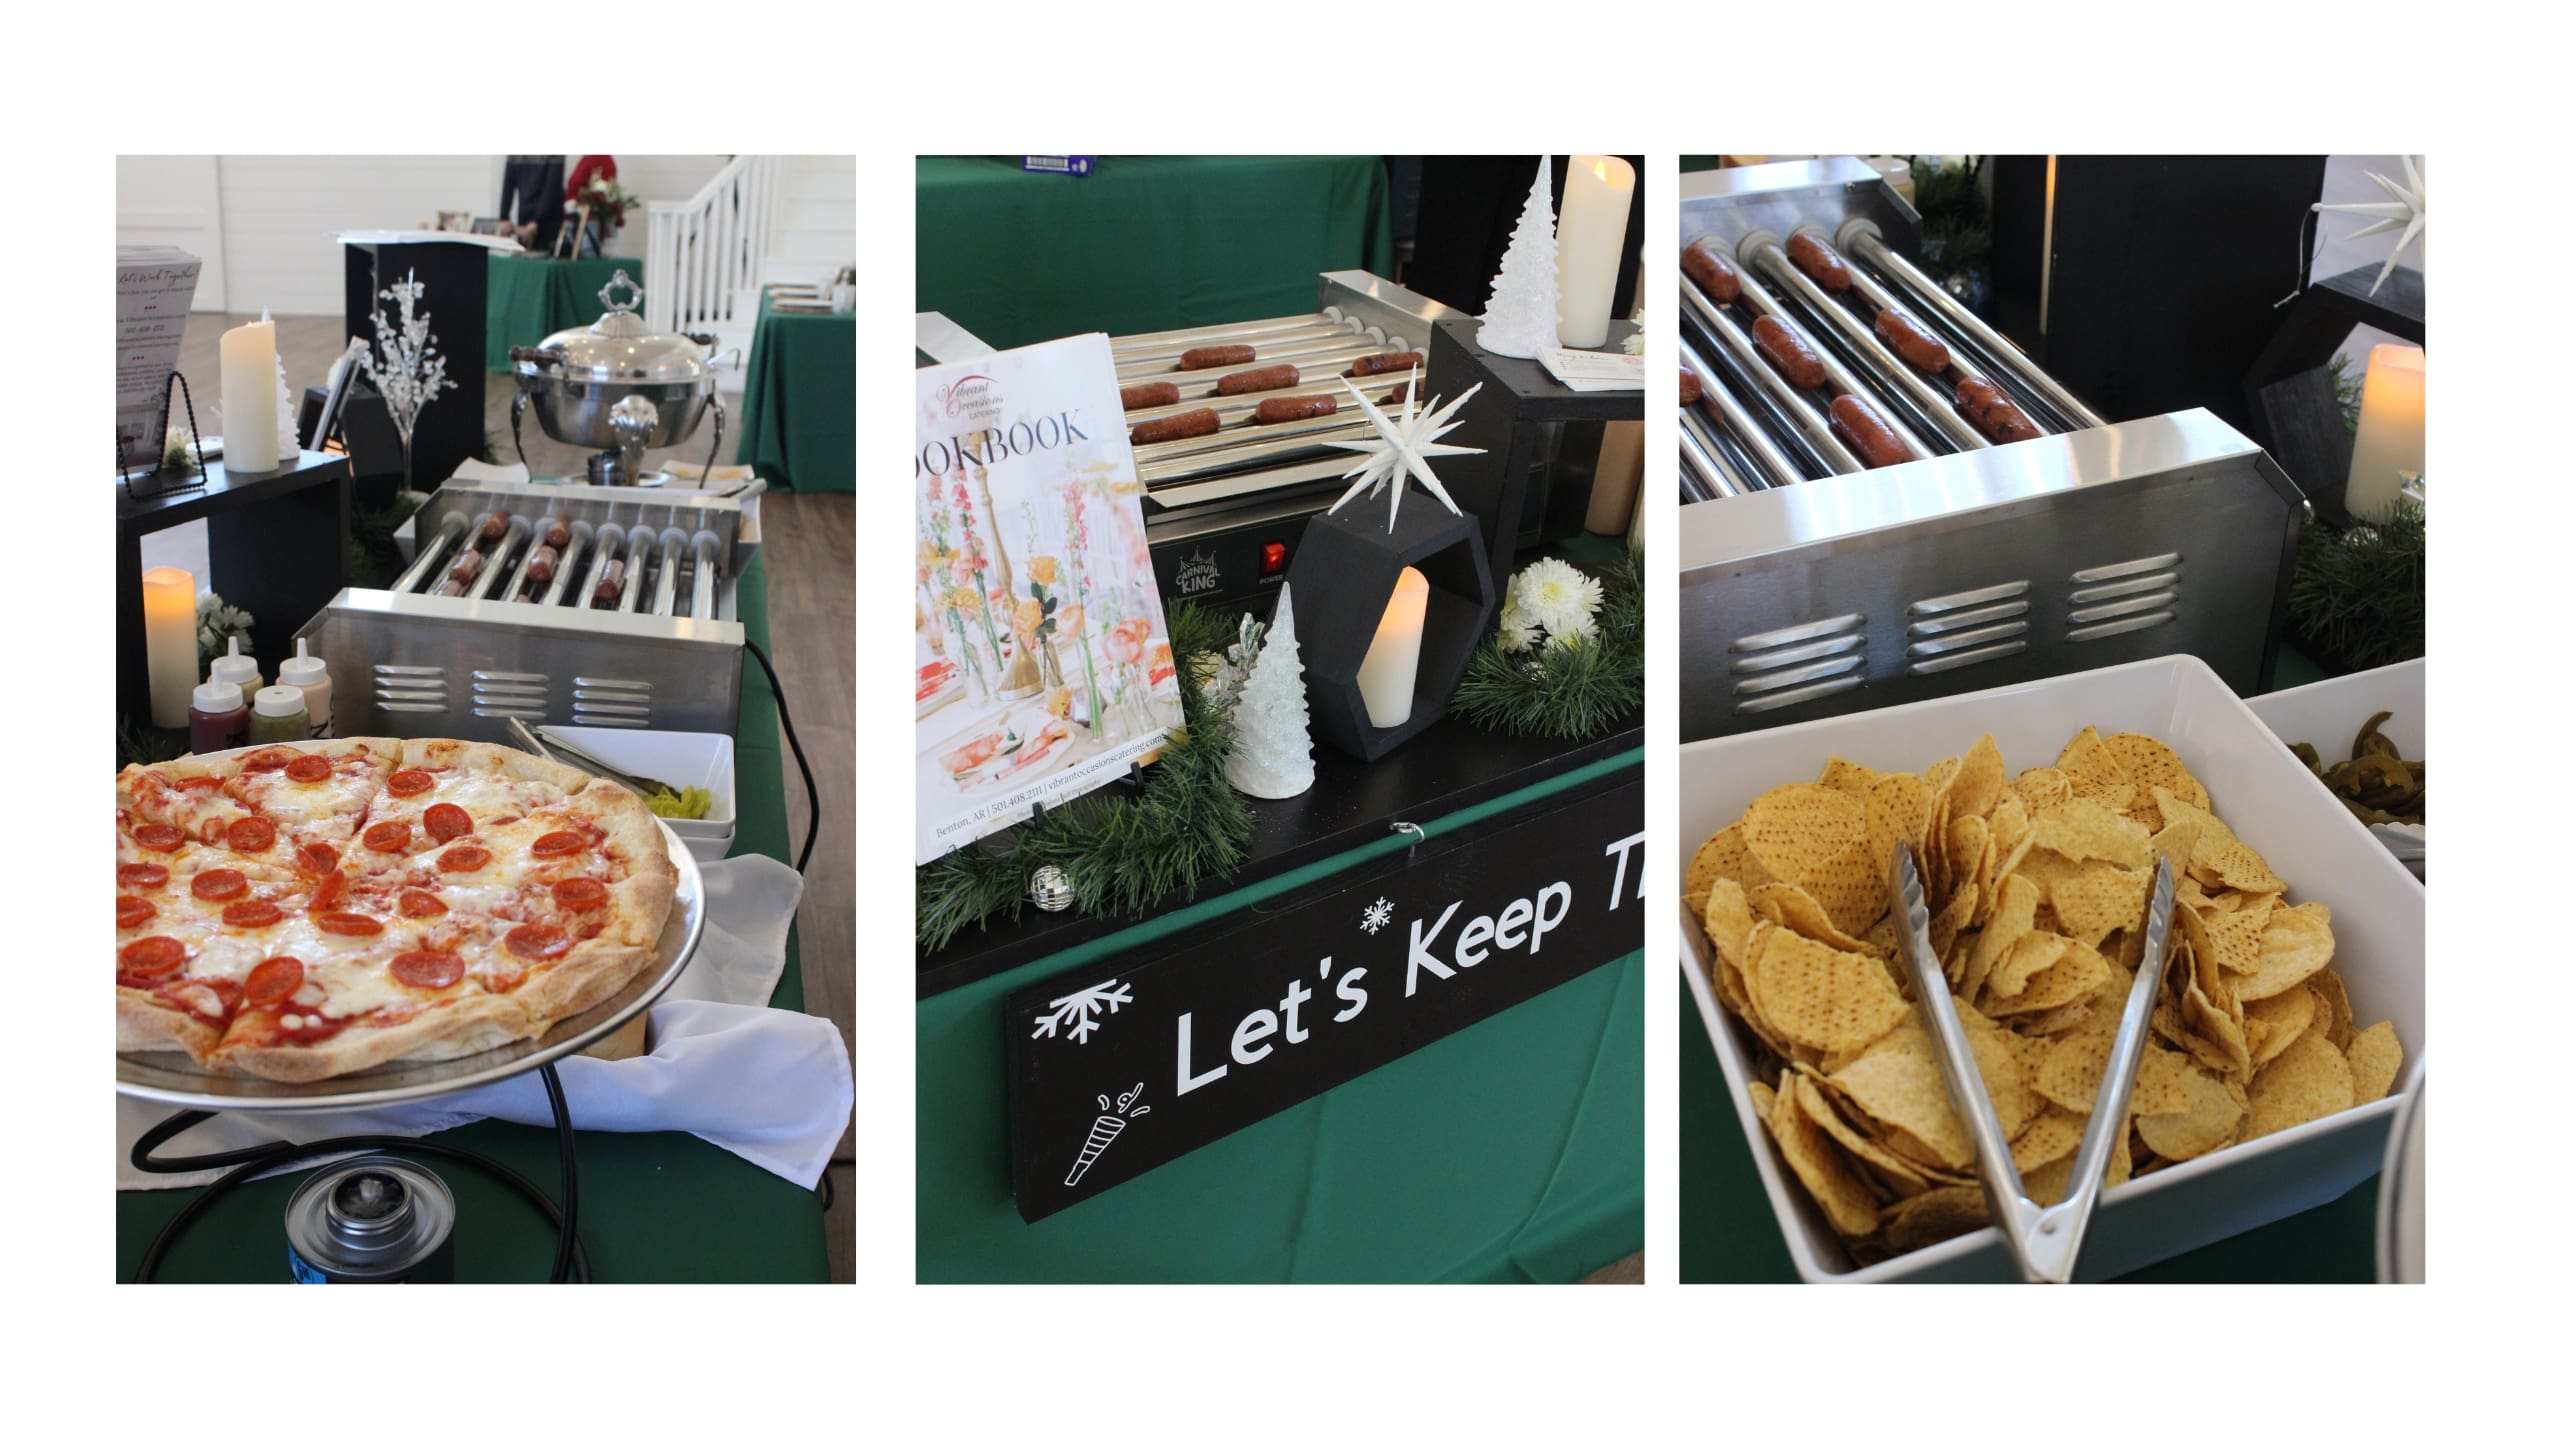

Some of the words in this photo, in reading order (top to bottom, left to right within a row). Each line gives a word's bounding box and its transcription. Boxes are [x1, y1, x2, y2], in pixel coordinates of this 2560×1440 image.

[936, 376, 998, 403] Vibrant
[946, 394, 1003, 417] Occasions
[969, 408, 1000, 420] CATERING
[916, 408, 1088, 480] OKBOOK
[1176, 564, 1220, 585] CARNIVAL
[1181, 575, 1216, 594] KING
[1260, 574, 1283, 584] POWER
[973, 809, 986, 821] AR
[992, 786, 1043, 814] 501.408.2111
[1048, 735, 1163, 791] vibrantoccasionscatering.com
[1177, 956, 1368, 1097] Let's
[1405, 880, 1571, 998] Keep
